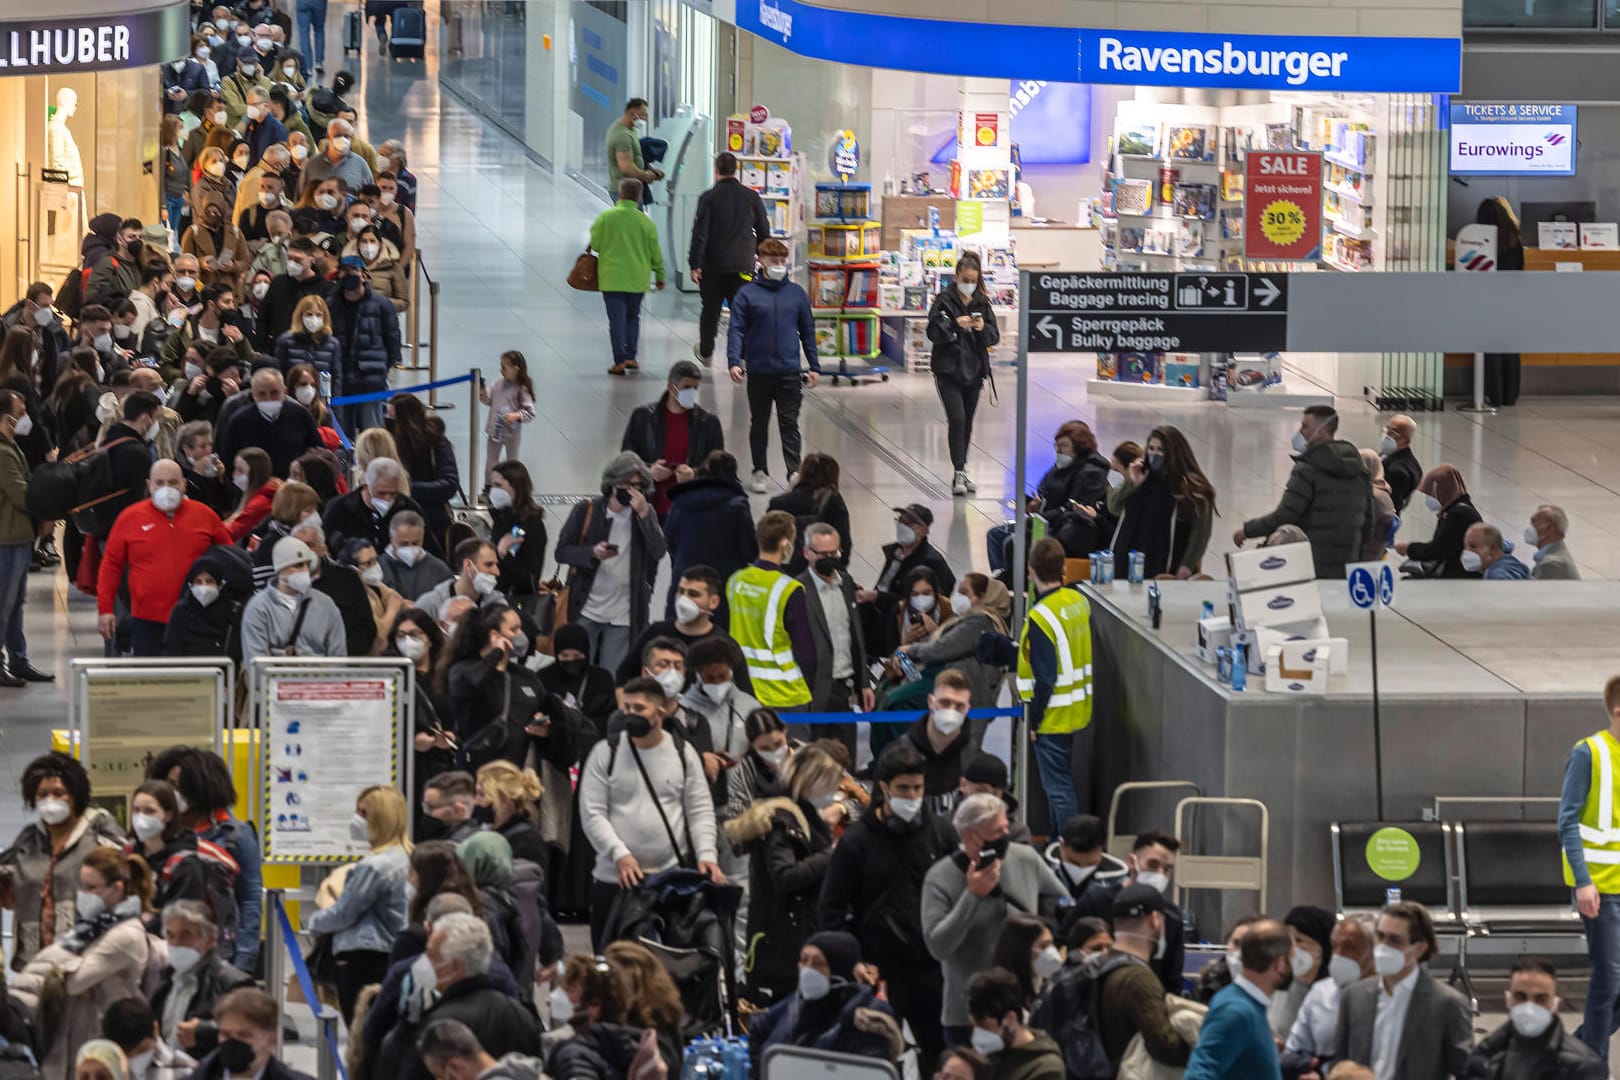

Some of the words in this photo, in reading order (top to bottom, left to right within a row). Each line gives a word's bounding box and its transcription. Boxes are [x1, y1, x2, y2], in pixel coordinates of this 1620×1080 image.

[0, 25, 130, 68] LHUBER
[1099, 37, 1348, 86] Ravensburger
[1464, 104, 1506, 116] TICKETS
[1508, 104, 1517, 116] &
[1520, 104, 1562, 116] SERVICE
[1458, 141, 1544, 160] Eurowings
[1260, 156, 1308, 175] SALE
[1254, 184, 1277, 194] Jetzt
[1277, 184, 1313, 194] sichern!
[1267, 211, 1286, 225] 30
[1288, 211, 1302, 224] %
[1039, 275, 1170, 291] Gepäckermittlung
[1050, 292, 1115, 309] Baggage
[1117, 292, 1169, 308] tracing
[1071, 317, 1165, 333] Sperrgepäck
[1071, 334, 1114, 350] Bulky
[1117, 334, 1181, 350] baggage
